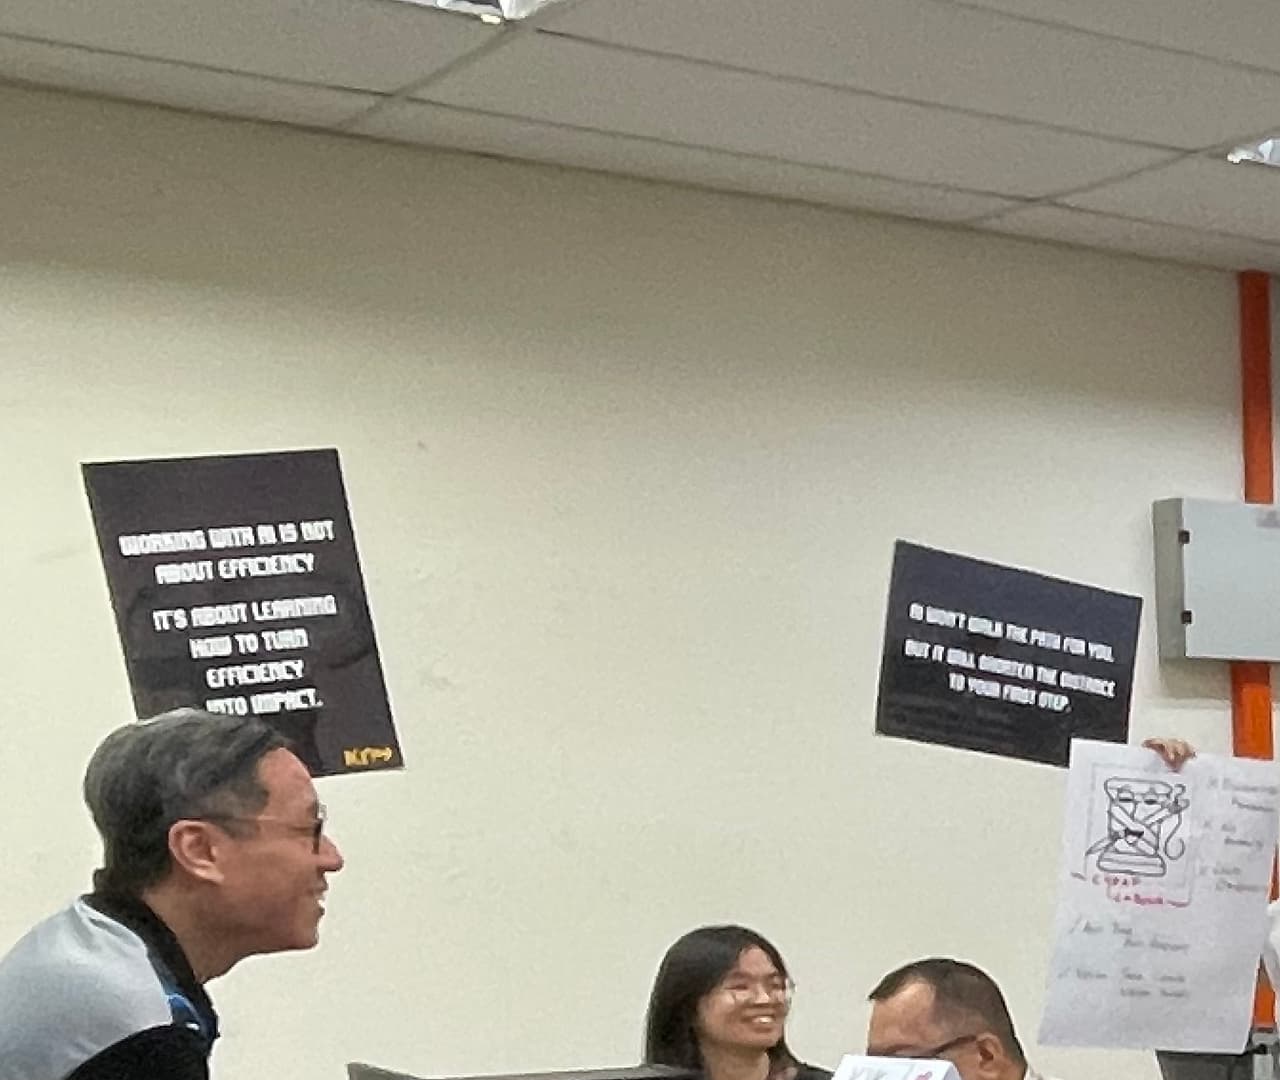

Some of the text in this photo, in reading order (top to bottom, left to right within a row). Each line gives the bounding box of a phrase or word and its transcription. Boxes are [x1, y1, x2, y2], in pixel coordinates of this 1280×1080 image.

[118, 519, 335, 556] WORKING WITH AI IS NOT
[154, 552, 315, 585] ABOUT EFFICIENCY
[152, 594, 338, 631] IT'S ABOUT LEARNING
[188, 628, 309, 659] HOW TO TURN
[205, 659, 304, 689] EFFICIENCY
[249, 687, 324, 715] IMPACT.
